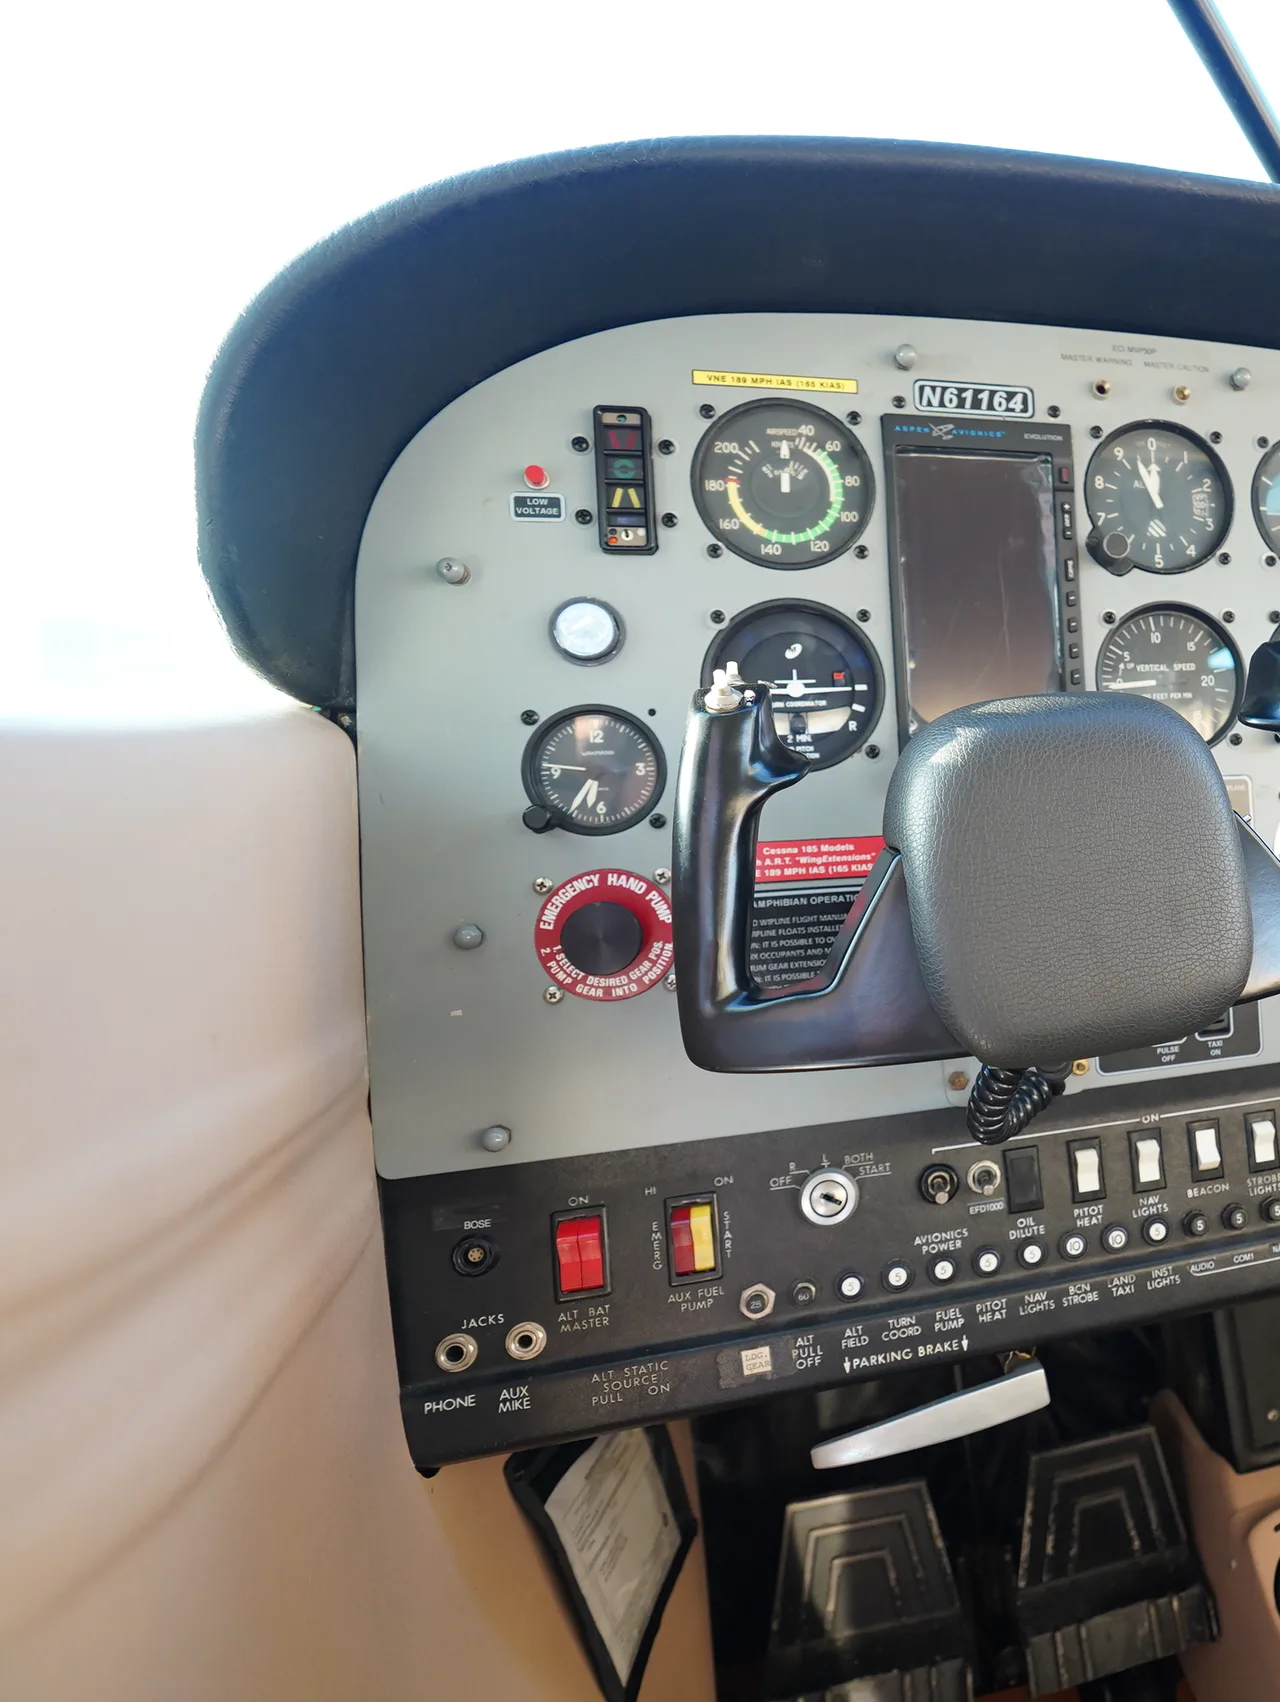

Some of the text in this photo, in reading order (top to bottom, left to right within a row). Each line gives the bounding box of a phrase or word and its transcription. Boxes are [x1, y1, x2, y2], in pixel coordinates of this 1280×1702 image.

[1061, 353, 1132, 366] MASTER WARNING
[1144, 361, 1210, 373] MASTER CAUTION
[707, 374, 846, 390] VNE 189 MPH IAS (165 KIAS)
[921, 386, 1025, 413] N61164
[798, 425, 815, 436] 40
[894, 425, 1003, 438] ASPEN AVIONICS
[1024, 433, 1063, 441] EVOLUTION
[714, 442, 739, 453] 200
[825, 441, 841, 451] 60
[705, 480, 725, 491] 180
[845, 475, 860, 486] 80
[516, 507, 559, 515] VOLTAGE
[840, 512, 858, 522] 100
[719, 519, 739, 529] 160
[761, 544, 781, 555] 140
[810, 541, 829, 552] 120
[1150, 632, 1161, 643] 10
[1187, 641, 1196, 651] 15
[1136, 663, 1196, 672] VERTICAL SPEED
[1201, 675, 1215, 687] 20
[786, 700, 827, 708] COORDINATOR
[589, 730, 604, 743] 12
[762, 843, 855, 856] Cessna 185 Models
[764, 858, 792, 867] A.R.T.
[765, 865, 848, 877] 189 MPH IAS (165
[539, 873, 673, 931] EMERGENCY HAND PUMP
[759, 915, 818, 927] WIPLINE FLIGHT
[778, 927, 806, 936] FLOATS
[779, 938, 813, 947] POSSIBLE
[759, 948, 823, 960] OCCUPANTS AND
[547, 941, 674, 998] PUMP GEAR INTO POSITION
[556, 953, 654, 987] SELECT DESIRED GEAR
[768, 963, 788, 971] GEAR
[781, 971, 815, 981] POSSIBLE
[1156, 1045, 1180, 1055] PULSE
[1207, 1040, 1223, 1048] TAXI
[1161, 1054, 1175, 1062] OFF
[1141, 1113, 1160, 1124] ON
[844, 1152, 874, 1165] BOTH
[859, 1162, 891, 1176] START
[713, 1175, 734, 1187] ON
[769, 1176, 792, 1188] OFF
[644, 1187, 657, 1196] HI
[1187, 1183, 1230, 1198] BEACON
[567, 1195, 589, 1207] ON
[1139, 1195, 1160, 1207] NAV
[969, 1202, 1004, 1215] EFD1000
[1073, 1205, 1104, 1218] PITOT
[1132, 1204, 1169, 1219] LIGHTS
[463, 1219, 492, 1230] BOSE
[1016, 1217, 1036, 1228] OIL
[1076, 1215, 1103, 1228] HEAT
[723, 1211, 734, 1259] START
[913, 1228, 969, 1246] AVIONICS
[1008, 1225, 1046, 1240] DILUTE
[1111, 1234, 1122, 1244] 10
[651, 1221, 663, 1271] EMERG
[922, 1240, 962, 1255] POWER
[1069, 1241, 1081, 1251] 10
[1233, 1253, 1255, 1264] COM1
[1151, 1266, 1173, 1279] INST
[1189, 1261, 1215, 1273] AUDIO
[1107, 1274, 1136, 1288] LAND
[1146, 1275, 1181, 1290] LIGHTS
[668, 1286, 725, 1304] AUX FUEL
[1068, 1283, 1090, 1296] BCN
[1112, 1285, 1135, 1297] TAXI
[1024, 1291, 1048, 1303] NAV
[1062, 1291, 1099, 1307] STROBE
[681, 1298, 714, 1313] PUMP
[750, 1300, 762, 1309] 25
[976, 1299, 1007, 1313] PITOT
[1019, 1300, 1055, 1316] LIGHTS
[557, 1305, 610, 1323] ALT BAT
[935, 1309, 962, 1321] FUEL
[978, 1311, 1007, 1324] HEAT
[461, 1314, 505, 1330] JACKS
[559, 1317, 610, 1333] MASTER
[888, 1316, 916, 1329] TURN
[934, 1318, 965, 1333] PUMP
[844, 1325, 863, 1338] ALT
[881, 1325, 922, 1342] COORD
[795, 1335, 815, 1348] ALT
[841, 1336, 869, 1349] FIELD
[745, 1351, 768, 1361] LDG.
[792, 1346, 823, 1359] PULL
[852, 1340, 960, 1370] PARKING BRAKE
[745, 1360, 771, 1372] GEAR
[796, 1356, 822, 1369] OFF
[591, 1360, 669, 1384] ALT STATIC
[602, 1374, 658, 1393] SOURCE
[499, 1385, 529, 1401] AUX
[591, 1383, 671, 1407] PULL ON
[424, 1394, 477, 1415] PHONE
[498, 1398, 531, 1414] MIKE
